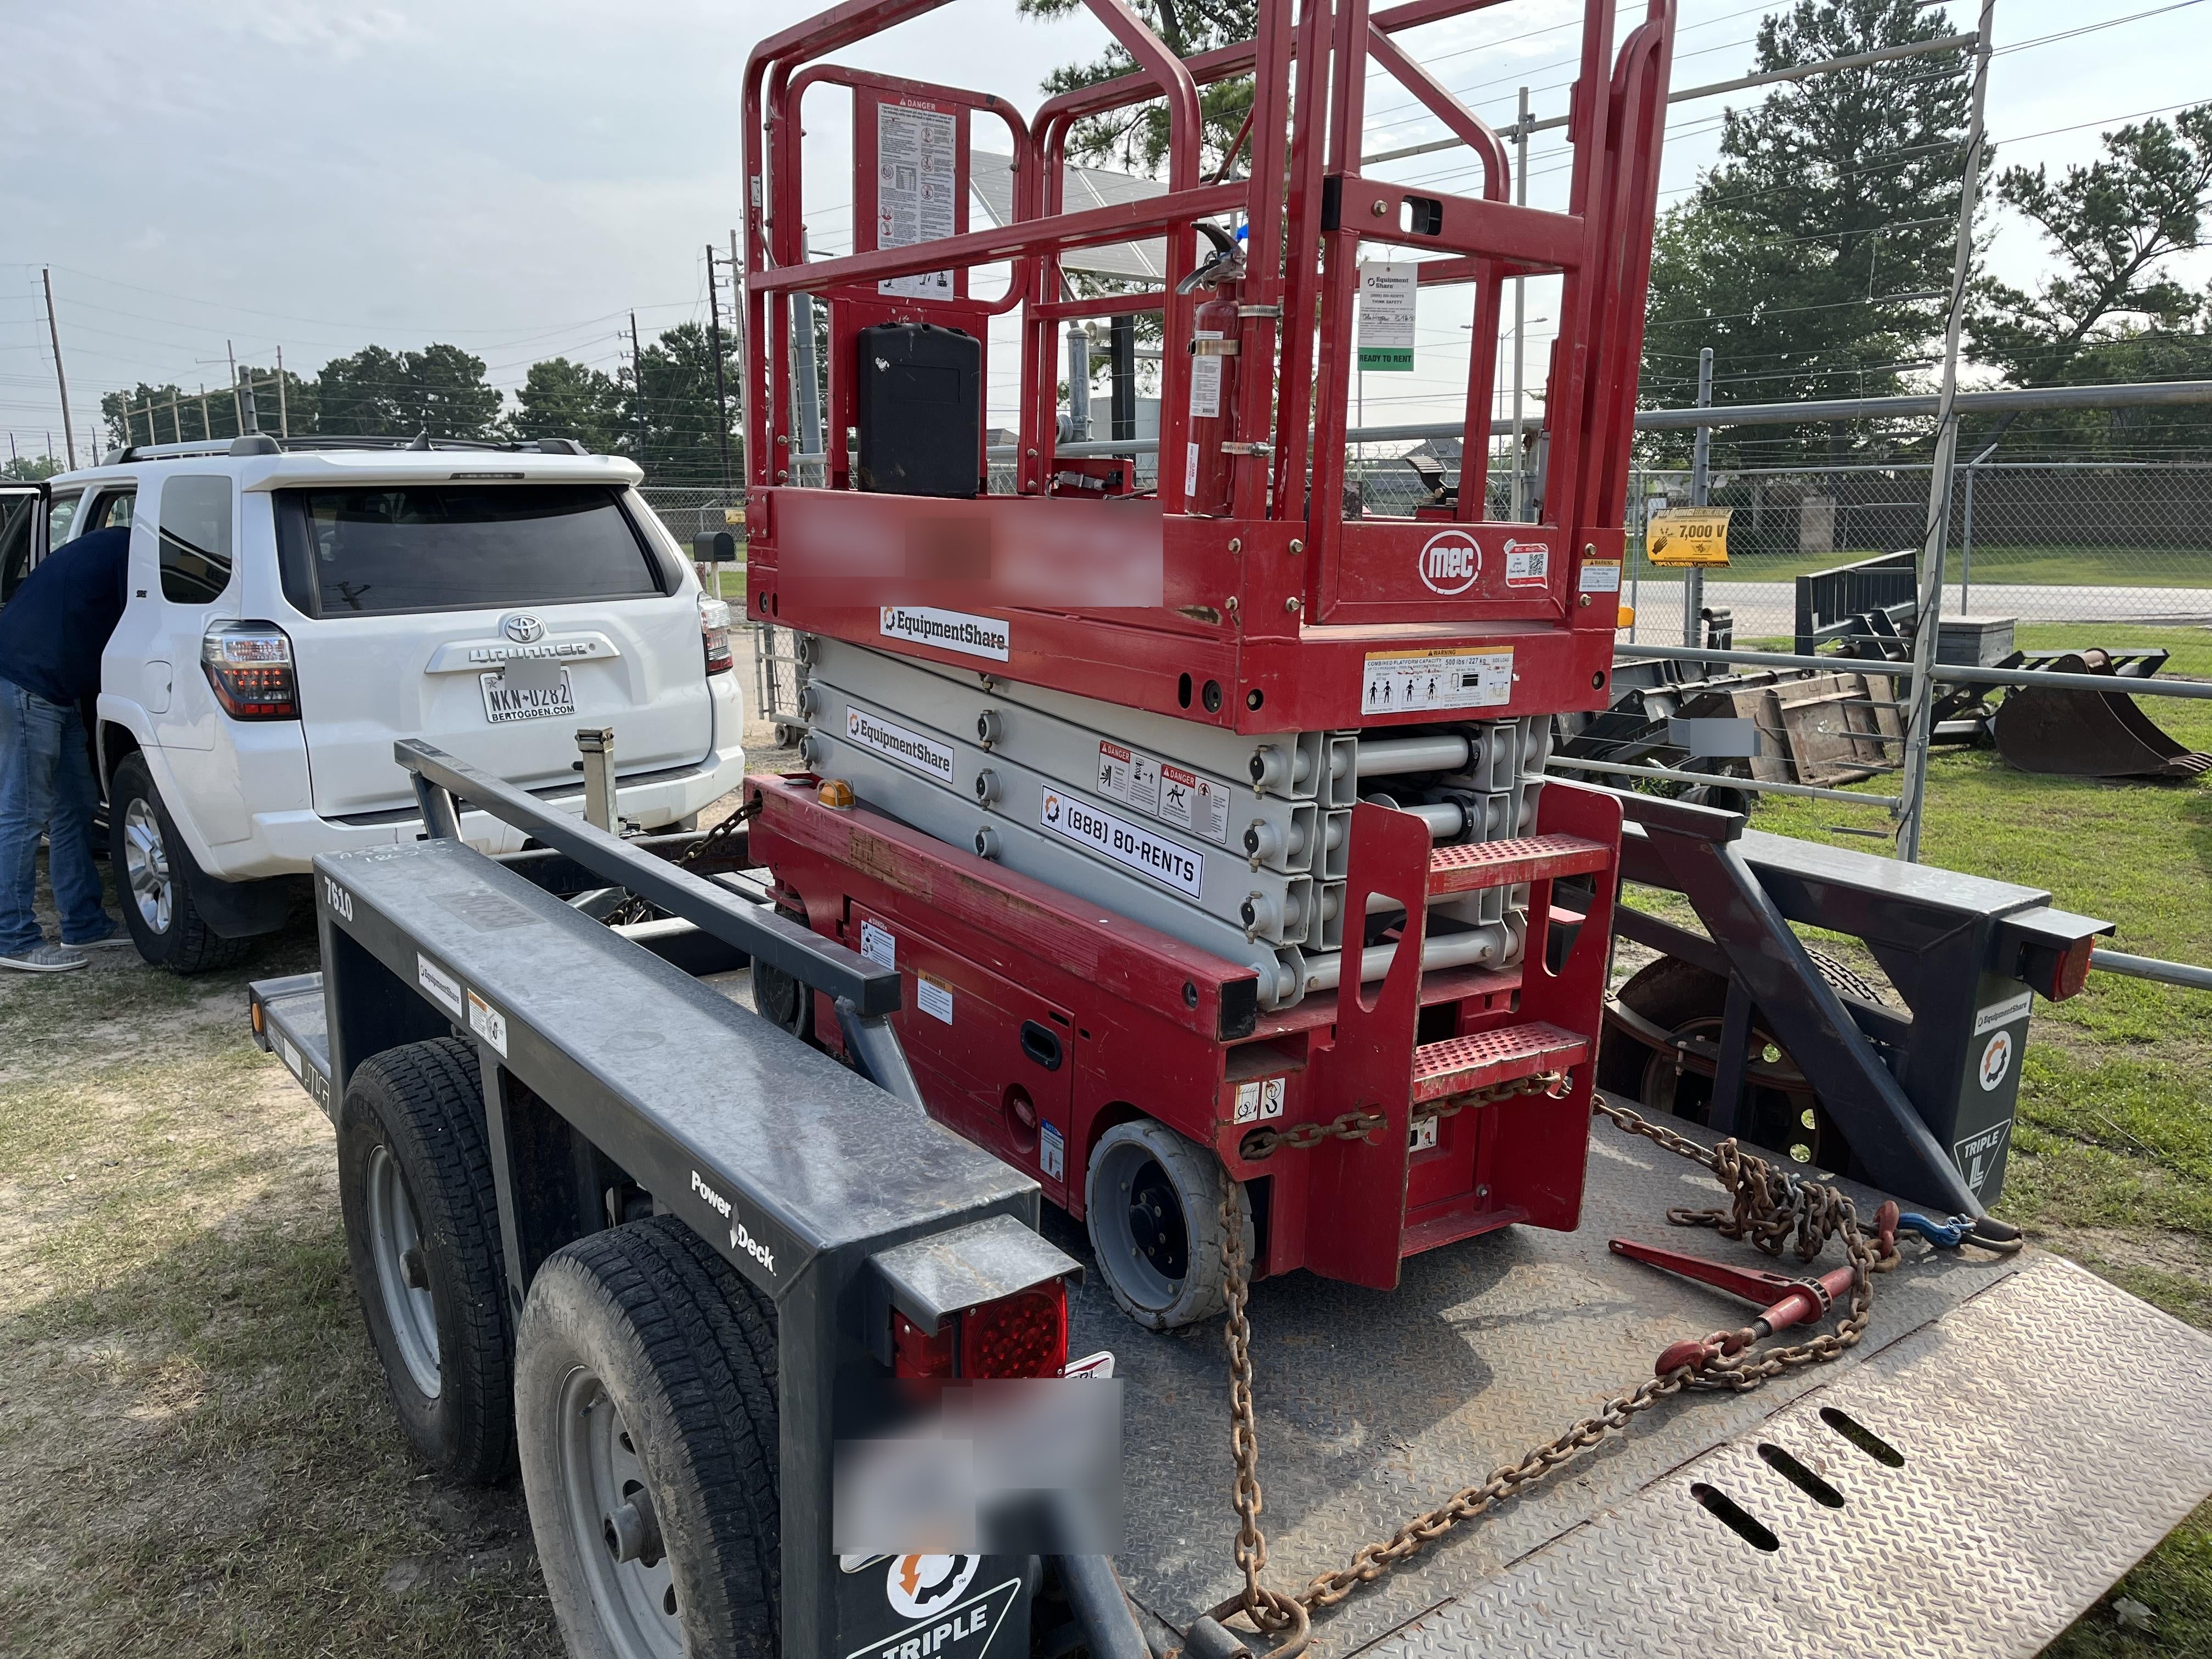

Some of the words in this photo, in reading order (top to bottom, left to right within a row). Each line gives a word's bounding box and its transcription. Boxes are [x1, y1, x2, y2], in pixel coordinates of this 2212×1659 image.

[907, 99, 935, 110] DANGER
[1695, 507, 1714, 516] ELECTRIC
[1680, 524, 1713, 540] 7,000
[1717, 524, 1725, 538] V
[897, 611, 1005, 650] EquipmentShare
[469, 643, 587, 663] 4RUNNER
[489, 690, 522, 712] NKN
[492, 705, 575, 721] BERTOGDEN.COM
[860, 719, 950, 772] EquipmentShare
[1108, 746, 1130, 761] DANGER
[1170, 770, 1195, 787] DANGER
[1068, 807, 1108, 844] (888)
[1114, 829, 1194, 882] 80-RENTS
[324, 876, 353, 922] 7610
[425, 968, 460, 1004] EquipmentShare
[1983, 1002, 2027, 1024] EquipmentShare
[1965, 1130, 1999, 1159] TRIPLE
[691, 1170, 731, 1218] Power
[737, 1223, 775, 1273] Deck
[883, 1604, 987, 1659] TRIPLE
